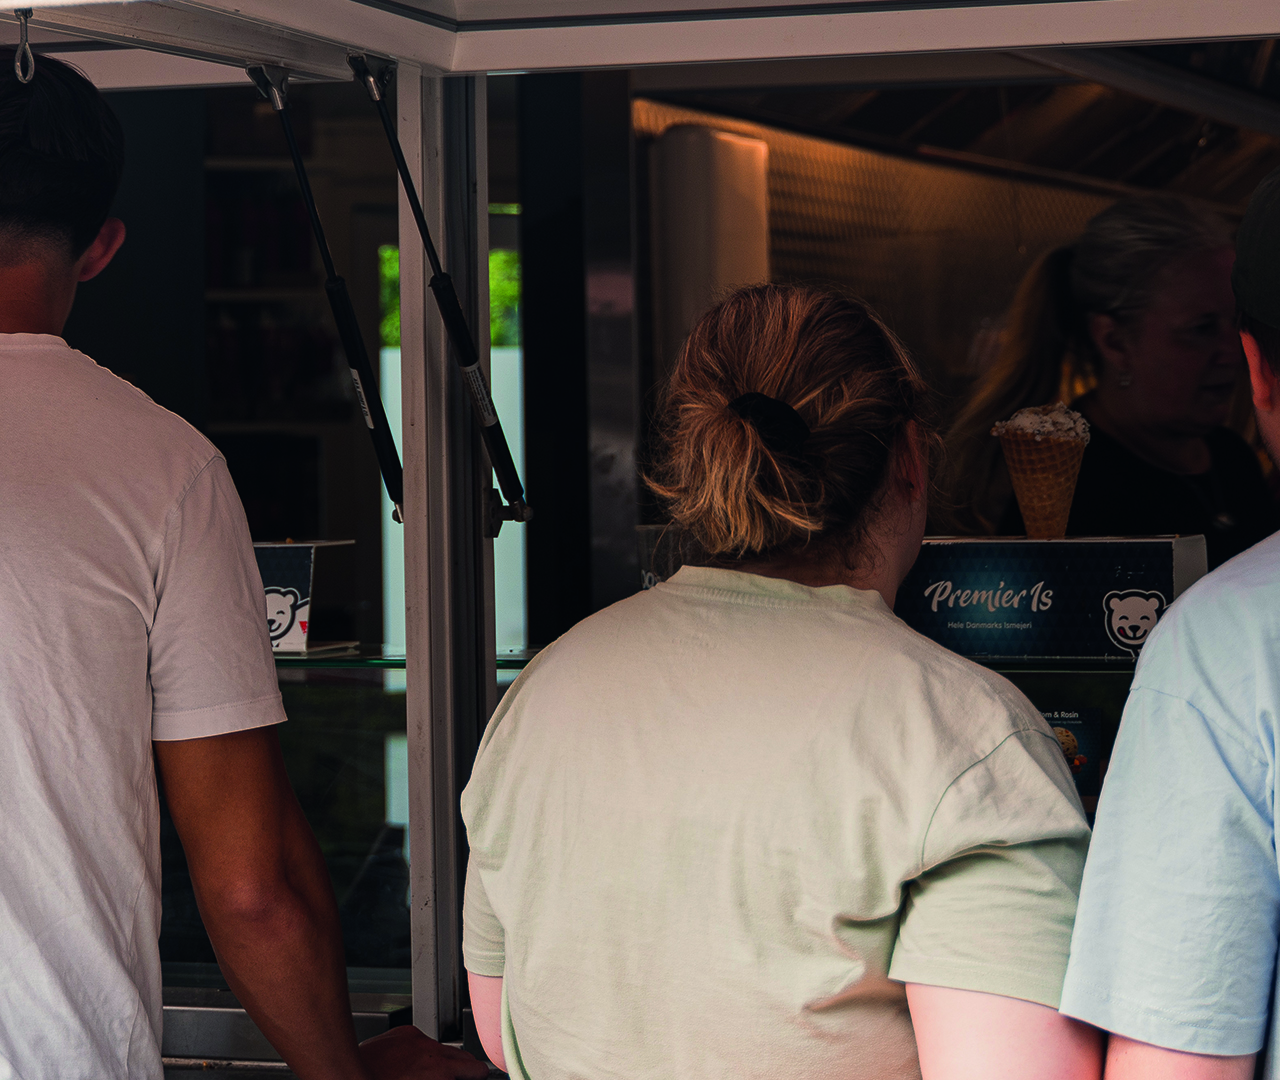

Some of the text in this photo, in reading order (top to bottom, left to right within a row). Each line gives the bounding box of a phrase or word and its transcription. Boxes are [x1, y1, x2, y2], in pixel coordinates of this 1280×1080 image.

[923, 580, 1054, 612] Premier Is
[947, 621, 1032, 631] Hele Danmarks Ismejeri
